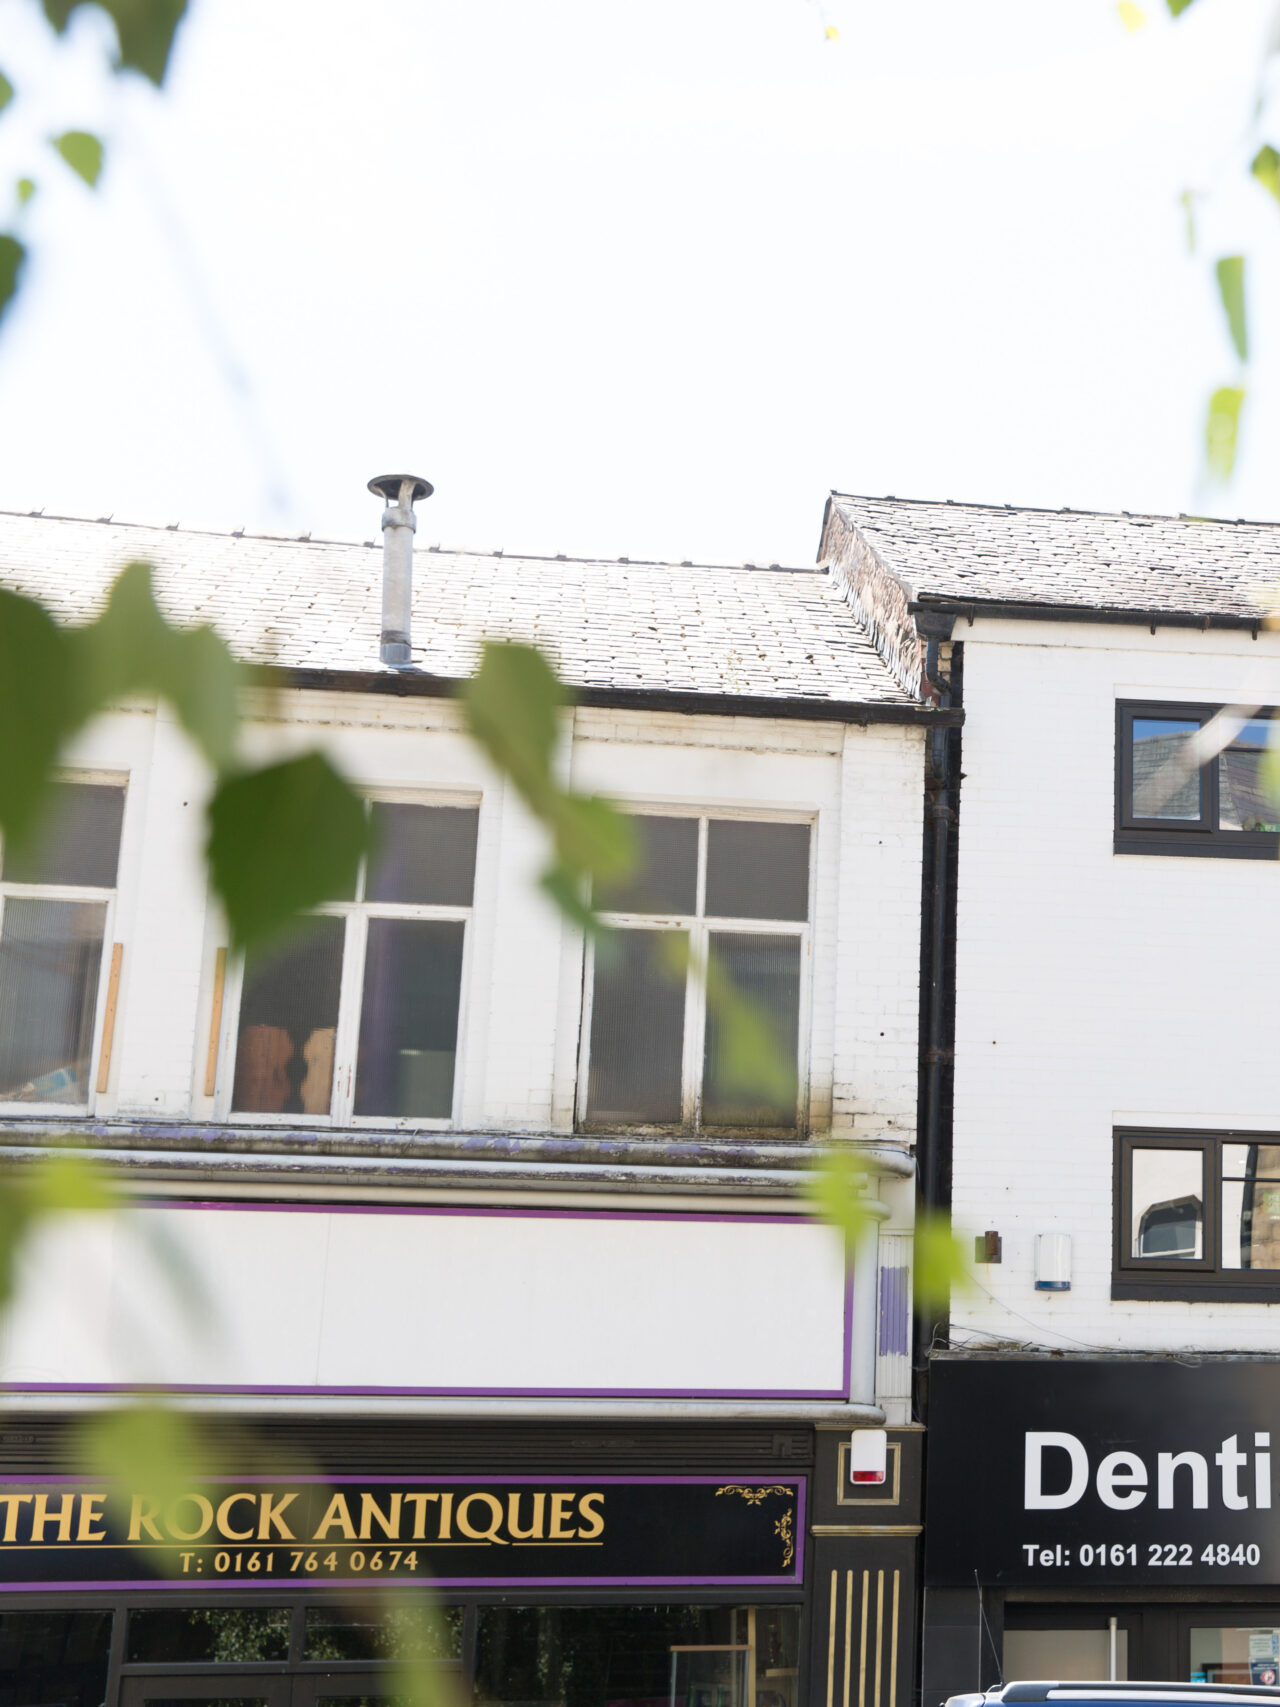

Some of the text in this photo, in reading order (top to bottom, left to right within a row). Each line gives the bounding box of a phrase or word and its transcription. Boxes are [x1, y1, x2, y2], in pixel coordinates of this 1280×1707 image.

[0, 1492, 605, 1546] THE ROCK ANTIQUES
[179, 1550, 418, 1573] T: 0161 764 0674
[1022, 1543, 1261, 1567] Tel: 0161 222 4840
